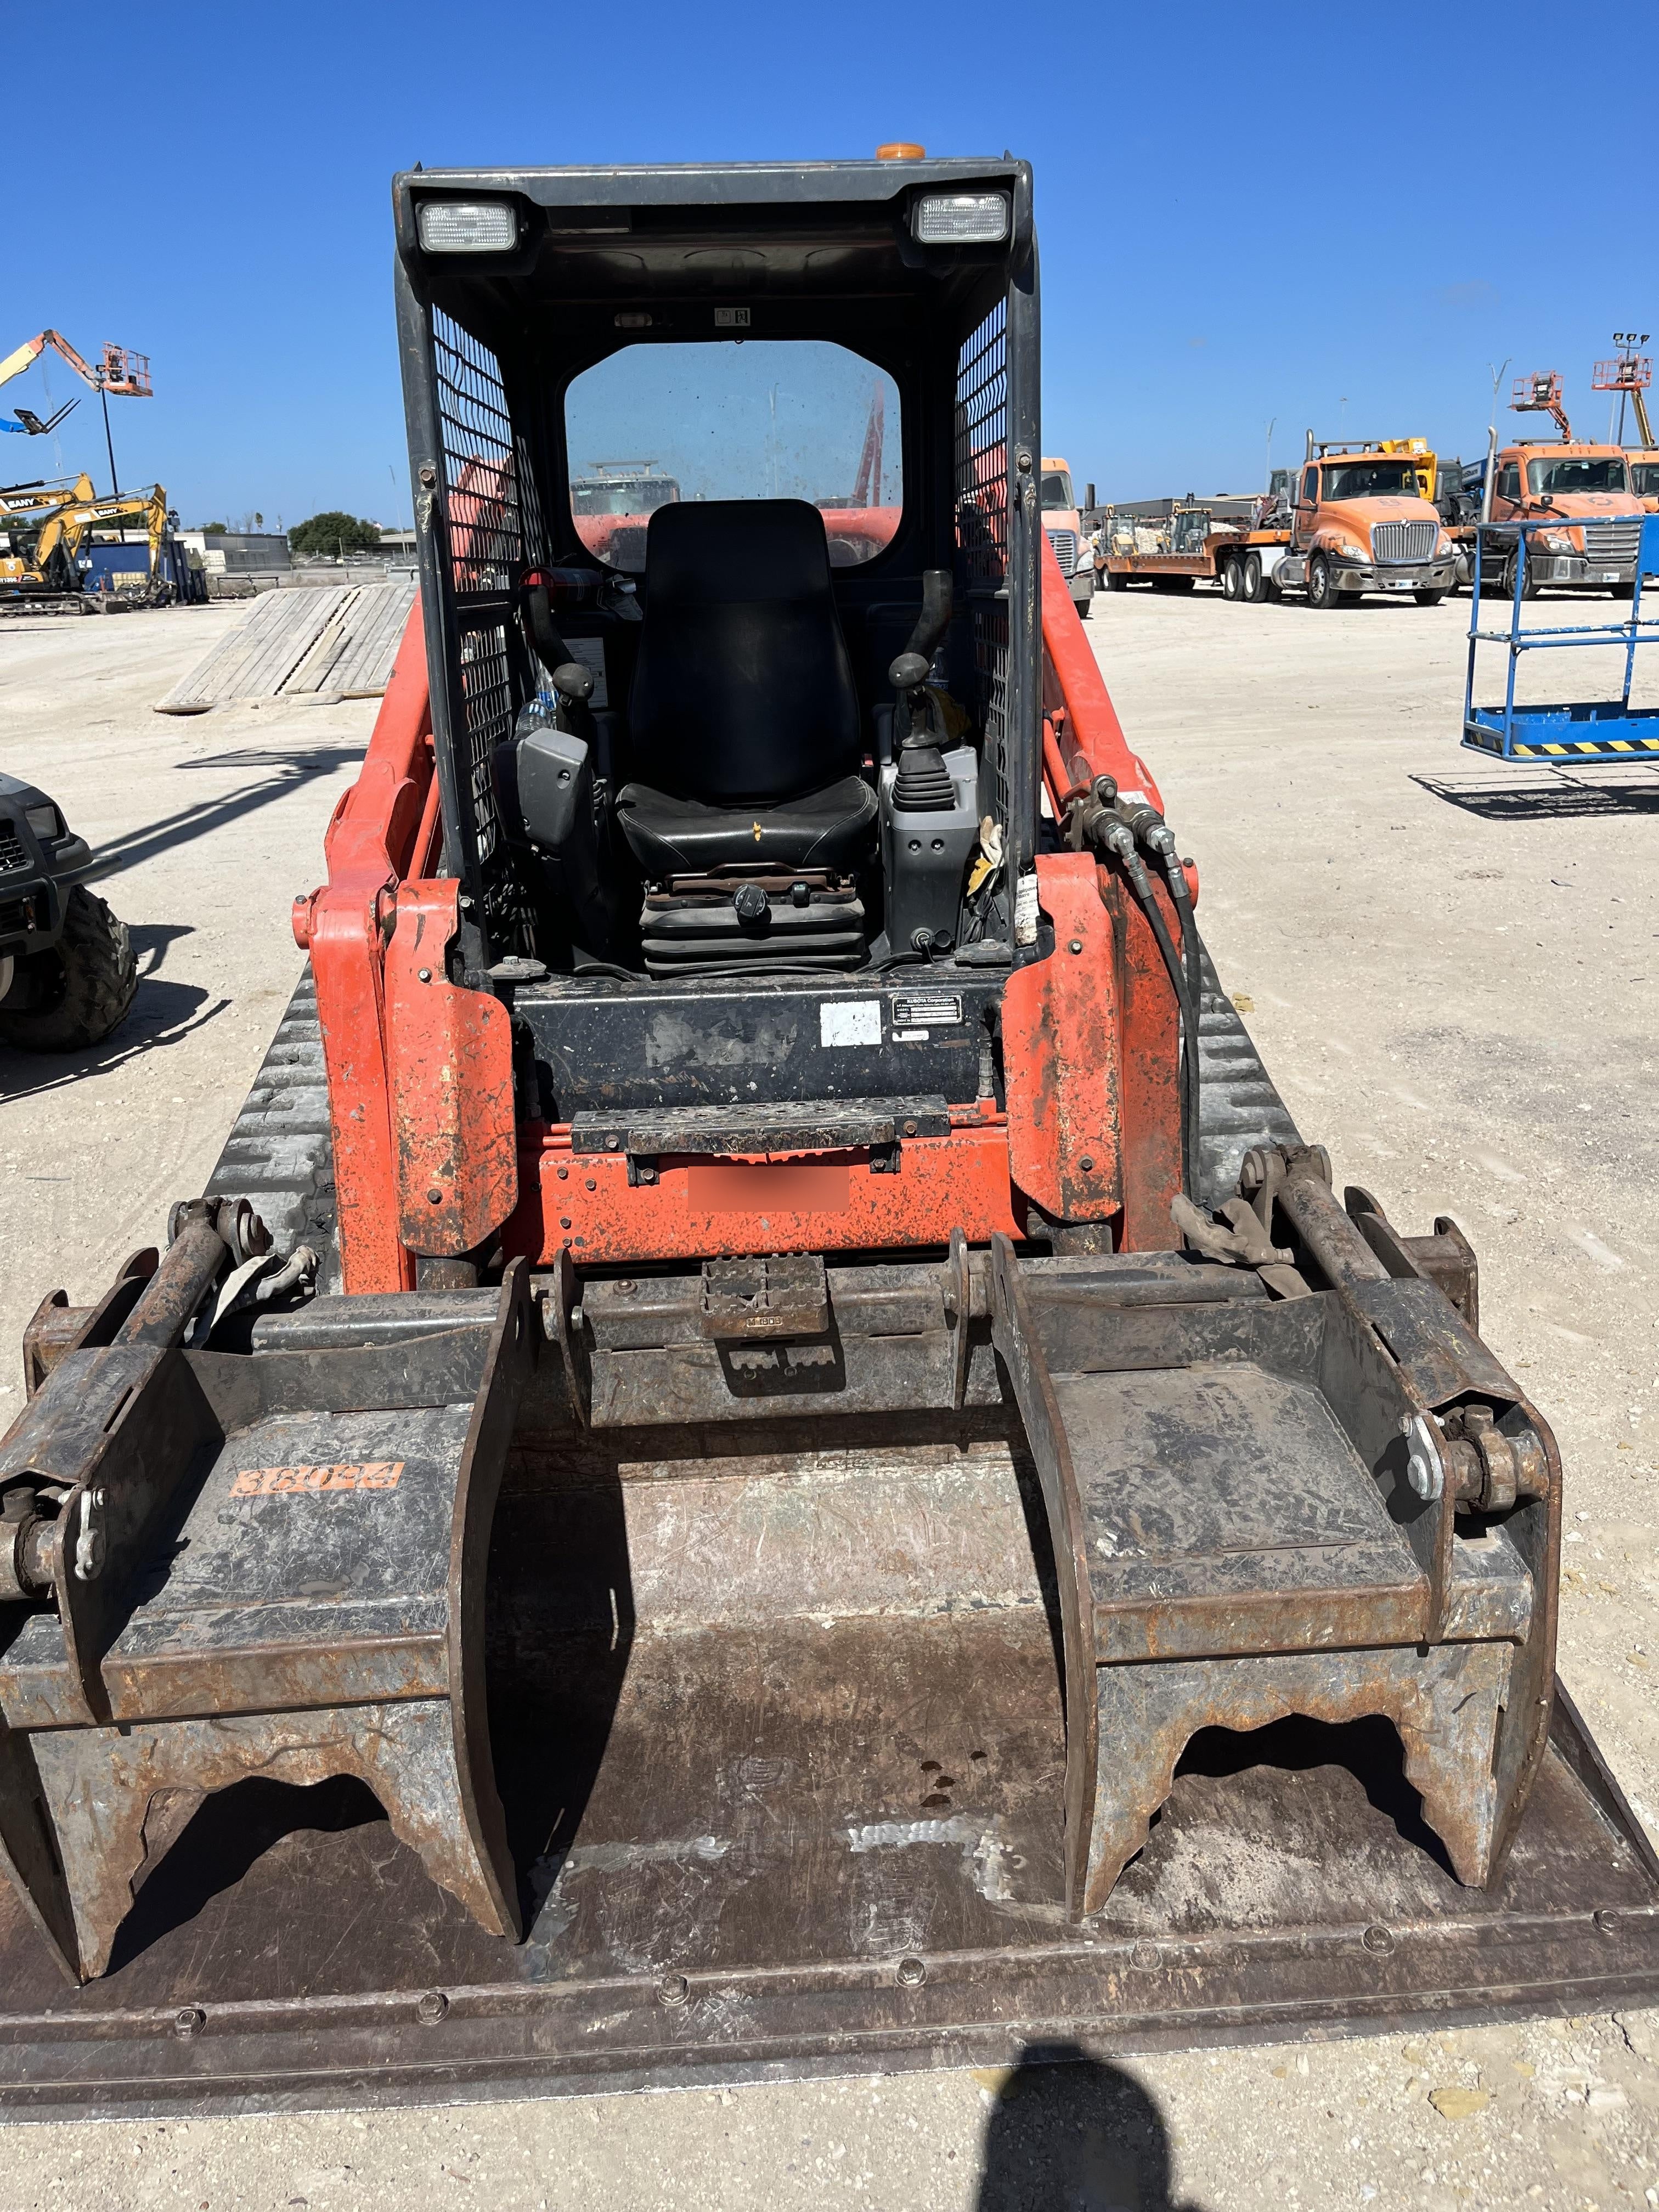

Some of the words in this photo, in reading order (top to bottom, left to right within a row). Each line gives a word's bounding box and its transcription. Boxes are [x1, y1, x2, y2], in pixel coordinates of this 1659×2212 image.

[8, 498, 35, 509] SANY
[99, 508, 117, 516] SANY
[236, 1463, 396, 1494] 38094
